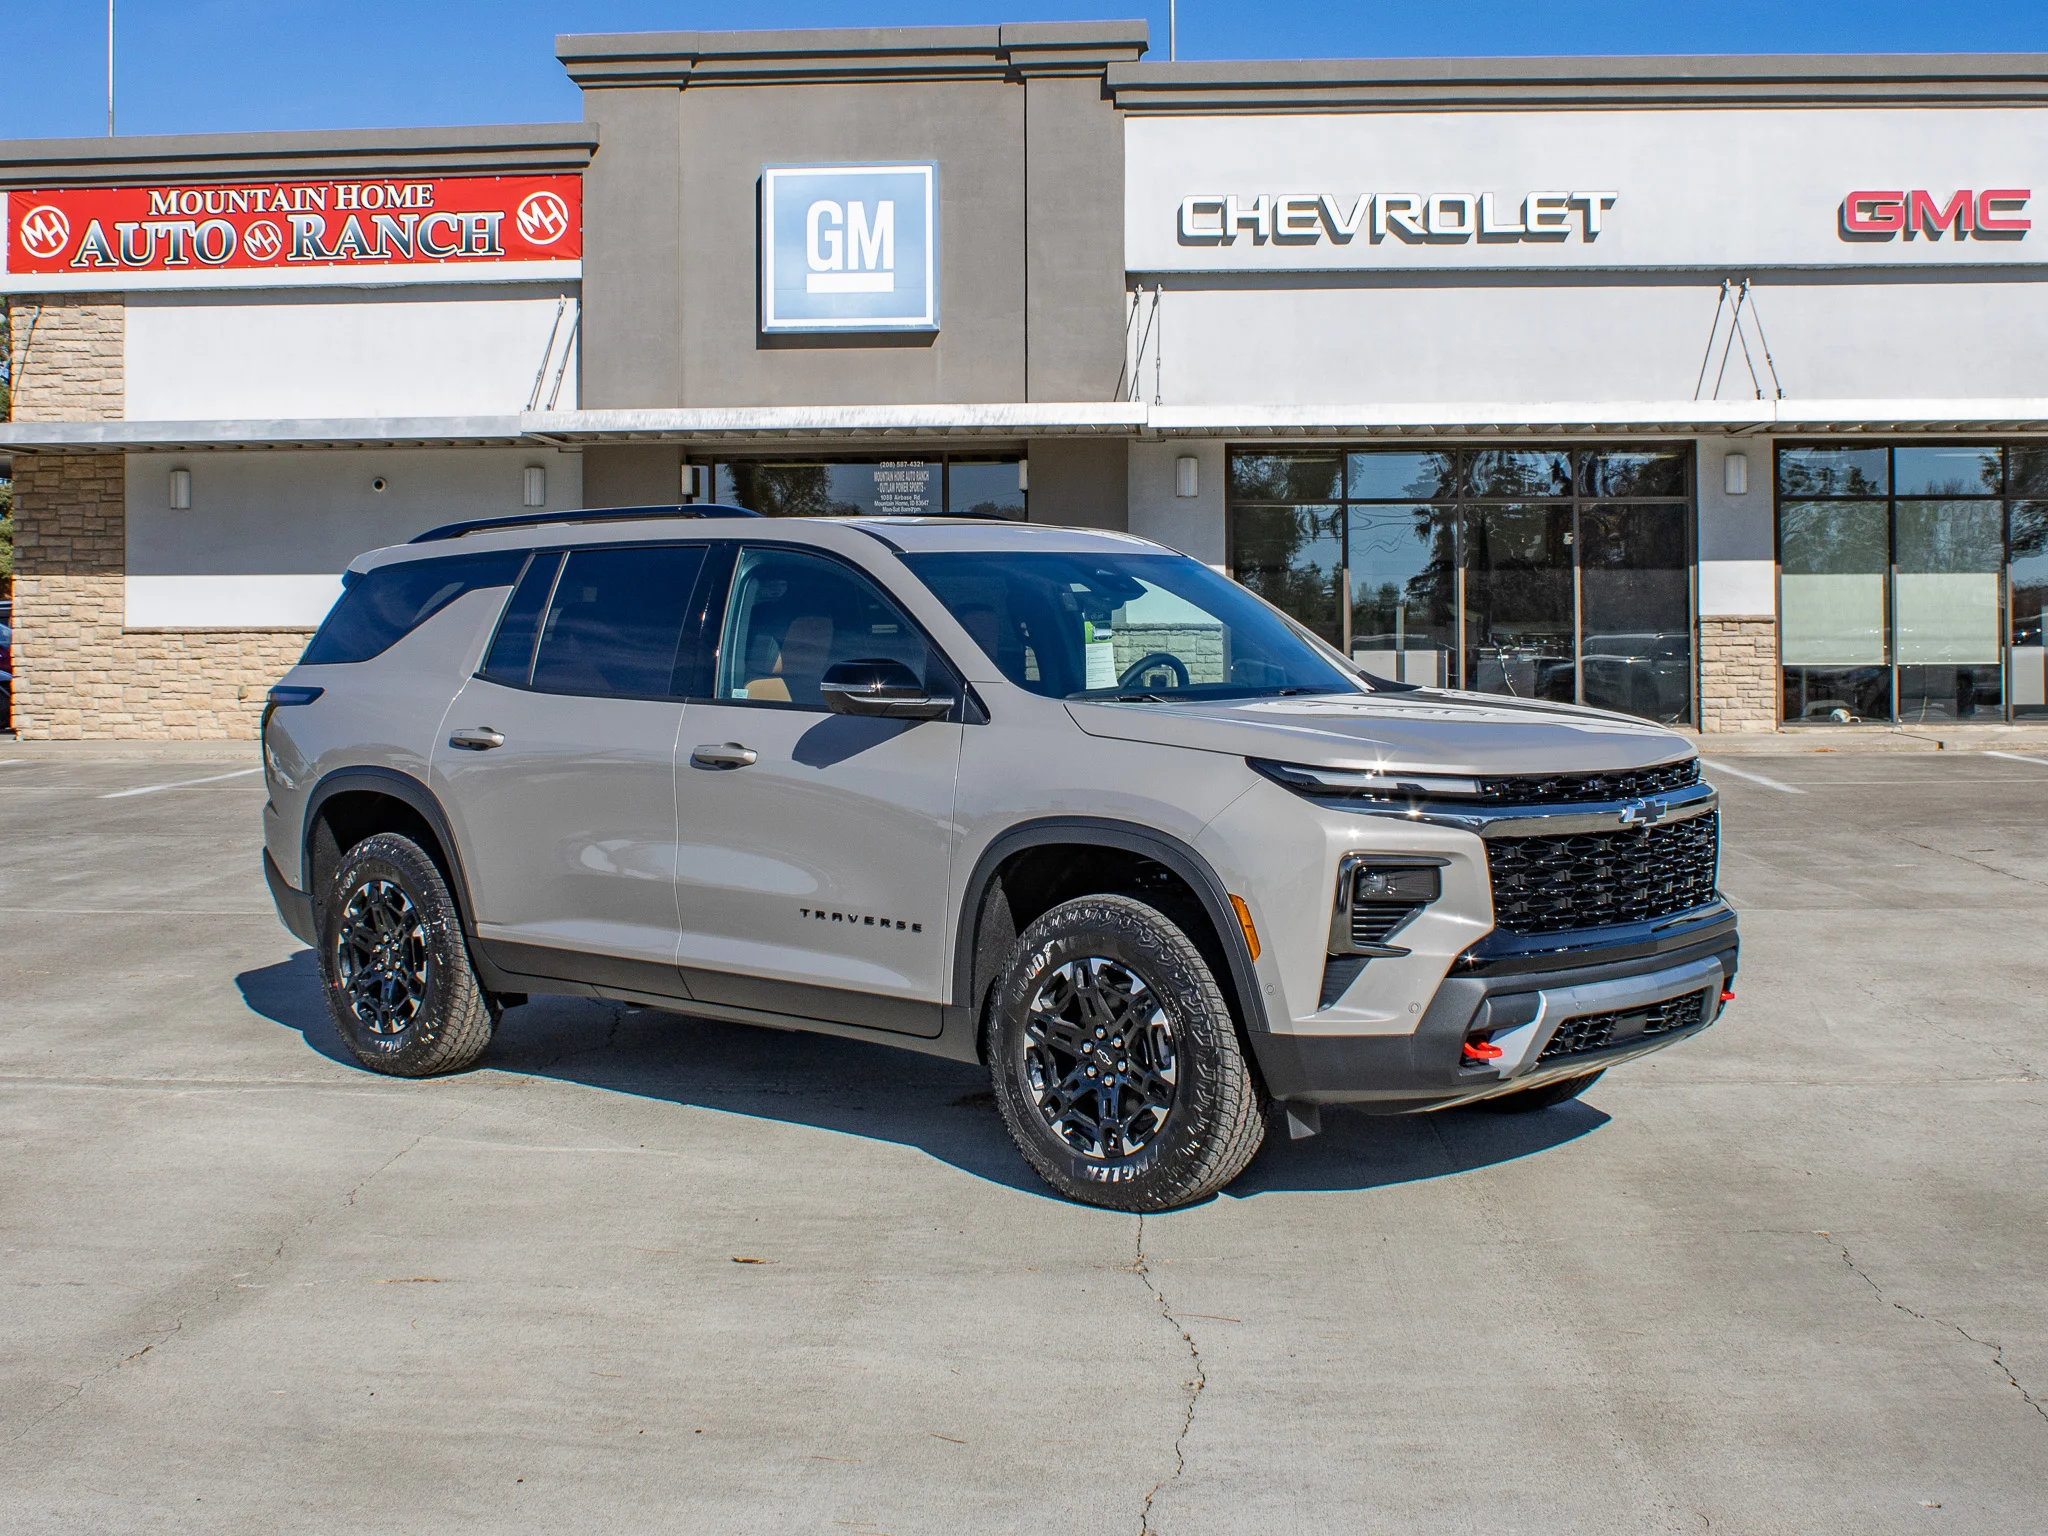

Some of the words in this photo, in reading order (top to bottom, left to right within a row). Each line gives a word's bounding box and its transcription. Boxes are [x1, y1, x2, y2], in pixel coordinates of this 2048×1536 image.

[148, 184, 328, 216] MOUNTAIN
[334, 183, 435, 211] HOME
[1180, 191, 1618, 239] CHEVROLET
[1844, 189, 2031, 234] GMC
[70, 219, 238, 267] AUTO
[286, 211, 505, 261] RANCH
[806, 200, 894, 271] GM
[874, 471, 894, 482] MOUNTAIN
[894, 471, 905, 481] HOME
[905, 471, 916, 481] AUTO
[916, 470, 930, 481] RANCH
[879, 461, 896, 469] (208)
[896, 482, 909, 492] POWER
[909, 482, 924, 493] SPORTS
[800, 908, 922, 933] TRAVERSE
